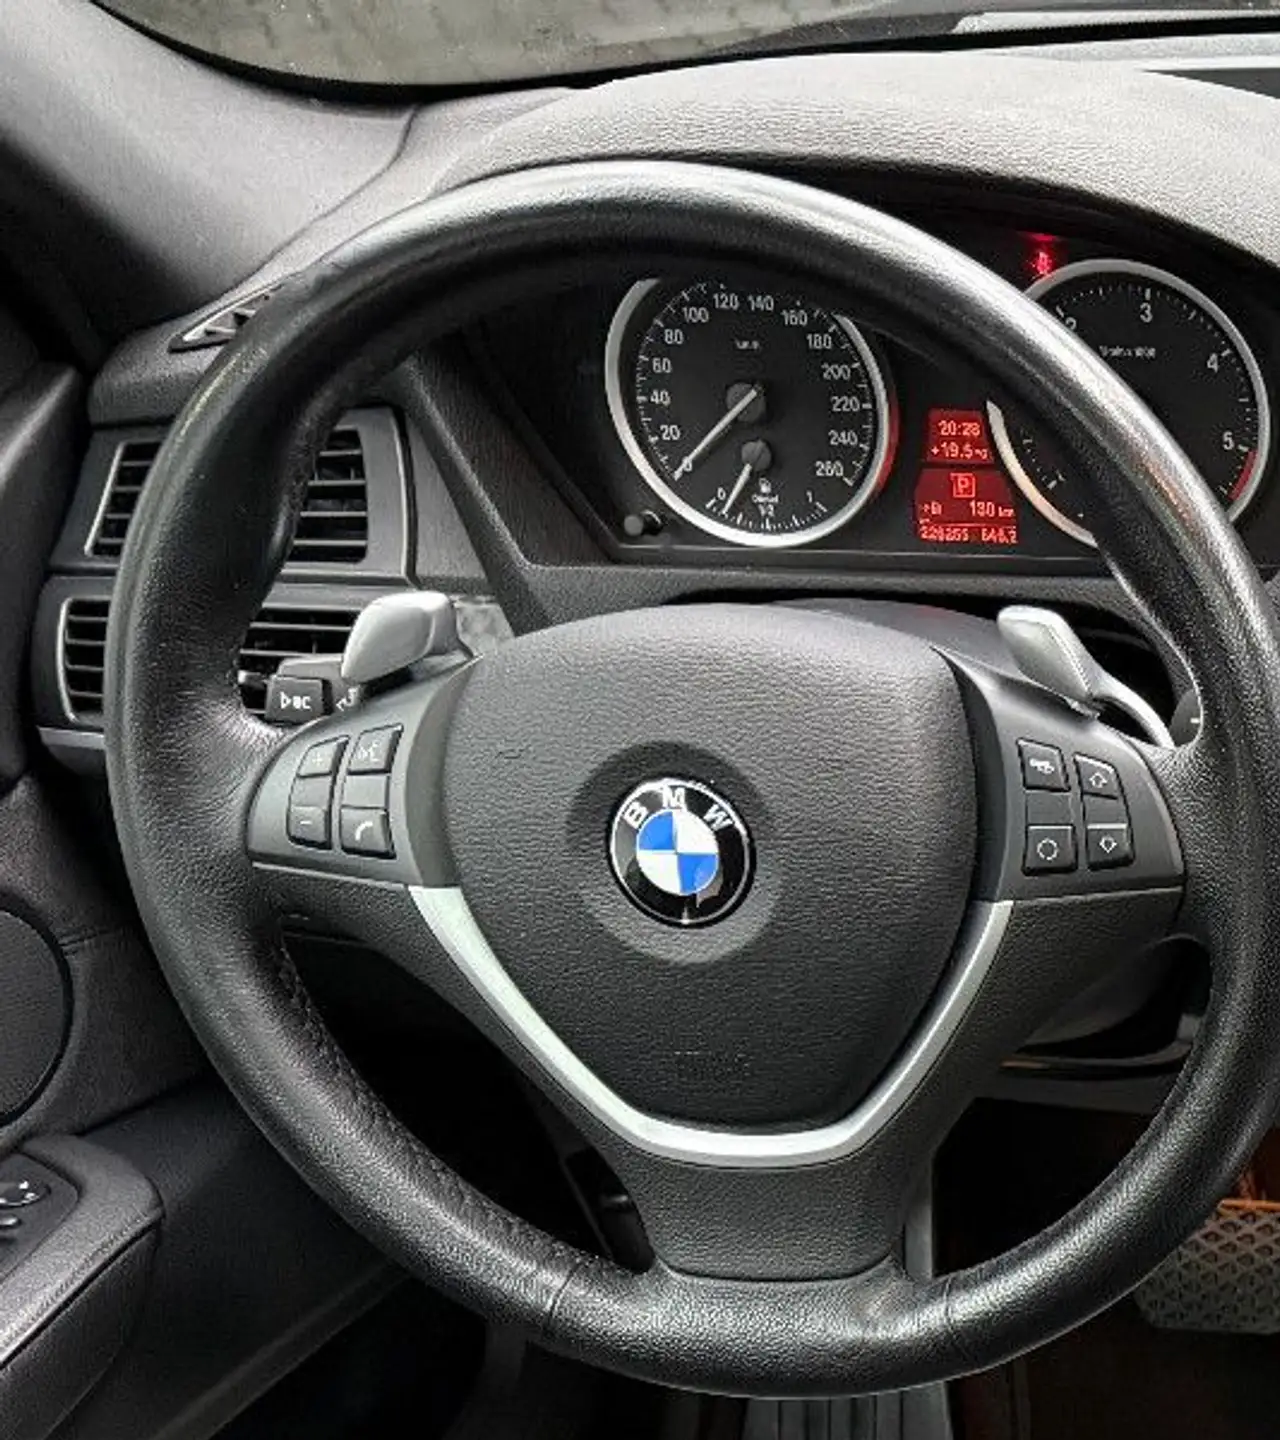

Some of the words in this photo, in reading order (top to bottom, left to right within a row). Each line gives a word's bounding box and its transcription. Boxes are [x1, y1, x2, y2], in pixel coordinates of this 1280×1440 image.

[713, 293, 740, 310] 120
[748, 294, 774, 311] 140
[682, 306, 709, 323] 100
[781, 309, 808, 326] 160
[1140, 304, 1153, 323] 3
[664, 328, 685, 345] 80
[807, 333, 832, 351] 180
[653, 357, 672, 374] 60
[1207, 352, 1219, 373] 4
[821, 364, 851, 380] 200
[650, 390, 670, 406] 40
[832, 395, 859, 412] 220
[660, 425, 681, 441] 20
[829, 429, 858, 446] 240
[1222, 431, 1235, 451] 5
[622, 785, 733, 831] BMW
